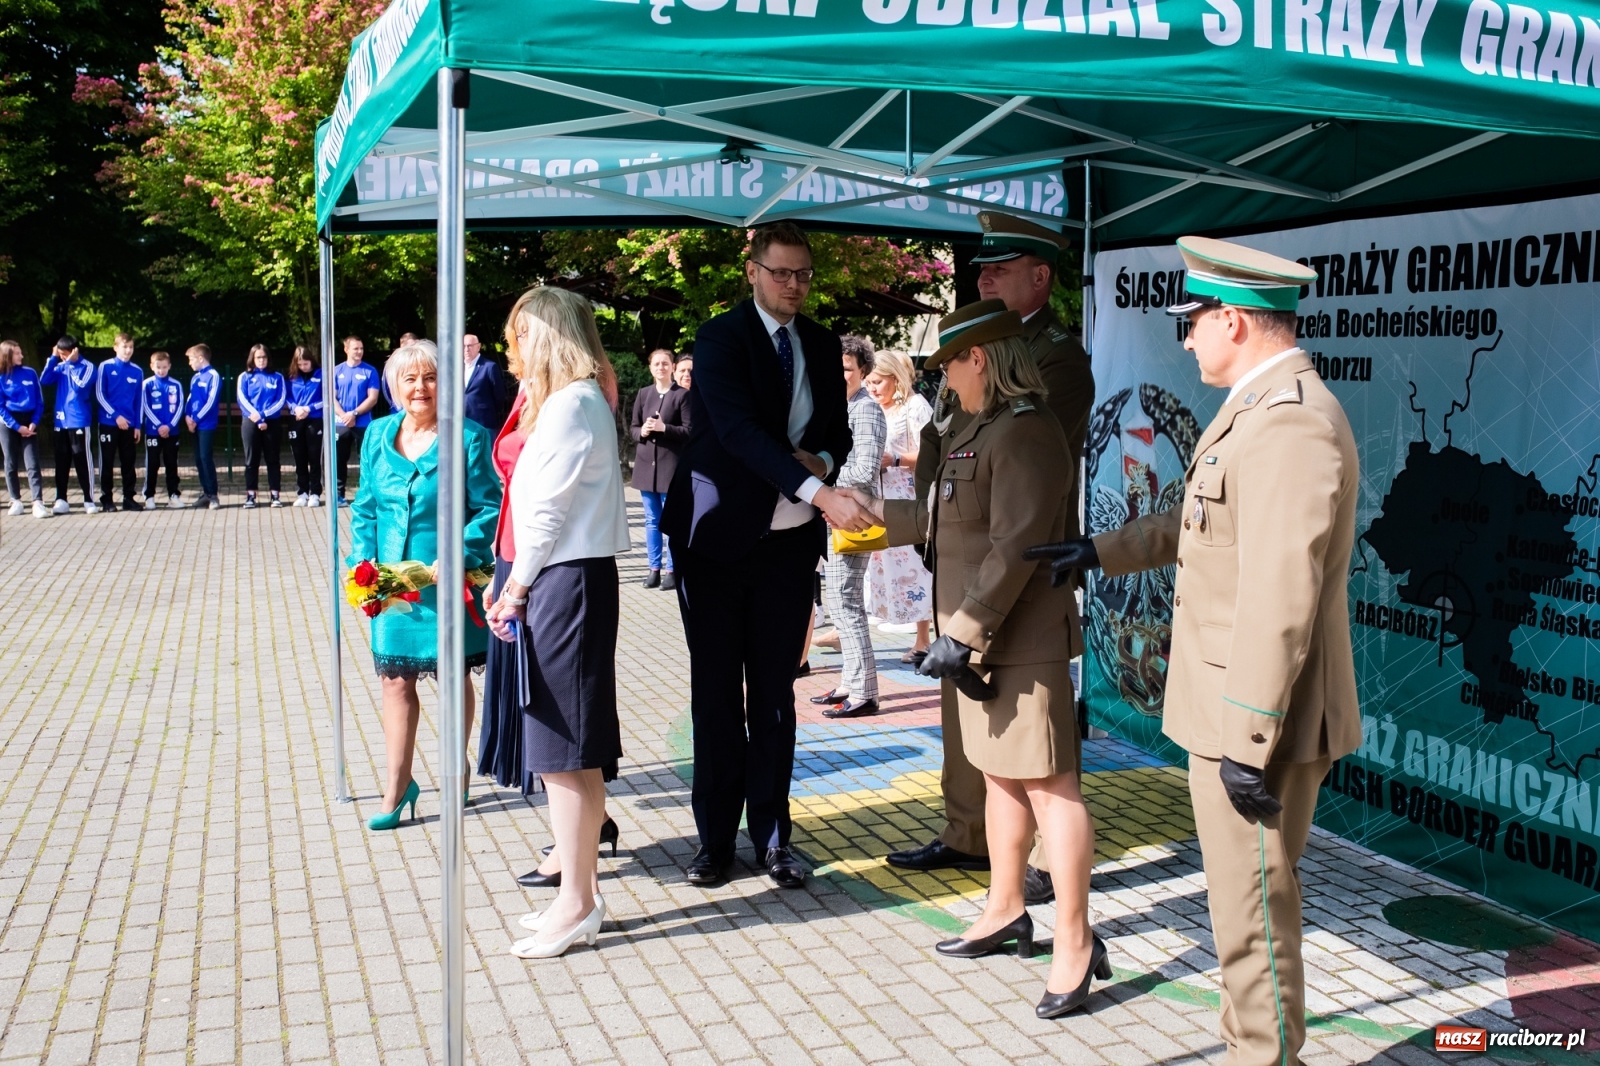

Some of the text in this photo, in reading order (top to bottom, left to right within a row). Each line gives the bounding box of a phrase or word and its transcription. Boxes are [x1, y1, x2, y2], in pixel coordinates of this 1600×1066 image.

[1406, 229, 1600, 294] GRANICZN
[1336, 305, 1498, 341] Bocheńskiego
[1526, 486, 1600, 518] Częstoc
[1507, 534, 1600, 572] Katowice-
[1355, 599, 1438, 642] RACIBÓRZ
[1492, 597, 1600, 640] Ruda Śląska
[1498, 660, 1567, 698] Bielsko
[1402, 729, 1600, 838] GRANICZN
[1389, 778, 1500, 854] BORDER
[1503, 820, 1600, 894] GUAR
